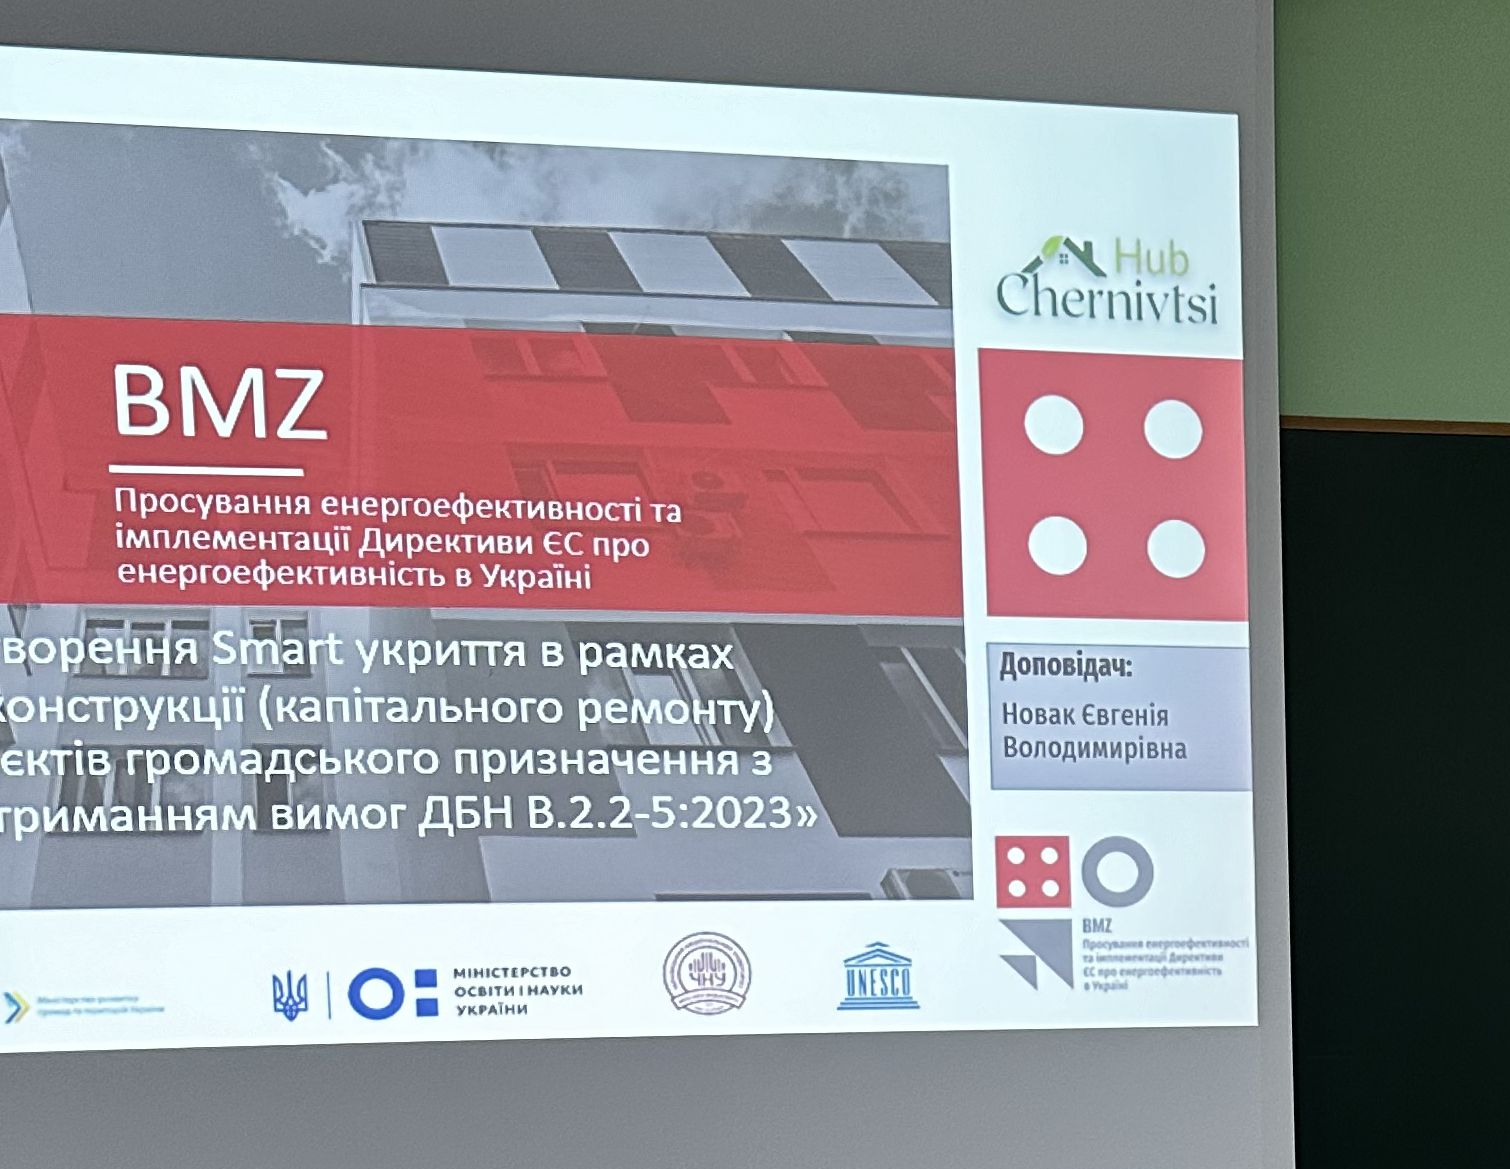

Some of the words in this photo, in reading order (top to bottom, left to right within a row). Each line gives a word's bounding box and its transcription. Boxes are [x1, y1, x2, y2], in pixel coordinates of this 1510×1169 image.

[1114, 236, 1190, 277] Hub
[996, 272, 1218, 325] Chernivtsi
[113, 363, 328, 441] BMZ
[114, 486, 311, 521] Просування
[320, 492, 642, 525] енергоефективності
[649, 502, 682, 523] та
[115, 521, 352, 557] імплементації
[358, 527, 534, 560] Директиви
[542, 531, 584, 556] ЄС
[593, 536, 650, 564] про
[117, 558, 446, 592] енергоефективність
[455, 567, 473, 588] в
[479, 563, 591, 595] Україні
[2, 637, 199, 673] ворення
[212, 630, 345, 666] Smart
[355, 639, 527, 674] укриття
[540, 641, 565, 667] в
[579, 641, 735, 676] рамках
[999, 650, 1133, 683] Доповідач:
[258, 684, 564, 731] (капітального
[578, 689, 774, 734] ремонту)
[1001, 701, 1077, 726] Новак
[1081, 701, 1169, 727] Євгенія
[0, 739, 111, 776] єктів
[126, 748, 440, 783] громадського
[454, 749, 739, 783] призначення
[751, 749, 774, 776] з
[1003, 734, 1188, 765] Володимирівна
[271, 804, 407, 831] вимог
[417, 795, 513, 838] ДБН
[1082, 917, 1113, 934] BMZ
[453, 965, 572, 980] МІНІСТЕРСТВО
[454, 985, 515, 998] ОСВІТИ
[527, 983, 583, 997] НАУКИ
[846, 968, 912, 998] UNESCO
[456, 1001, 528, 1017] УКРАЇНИ
